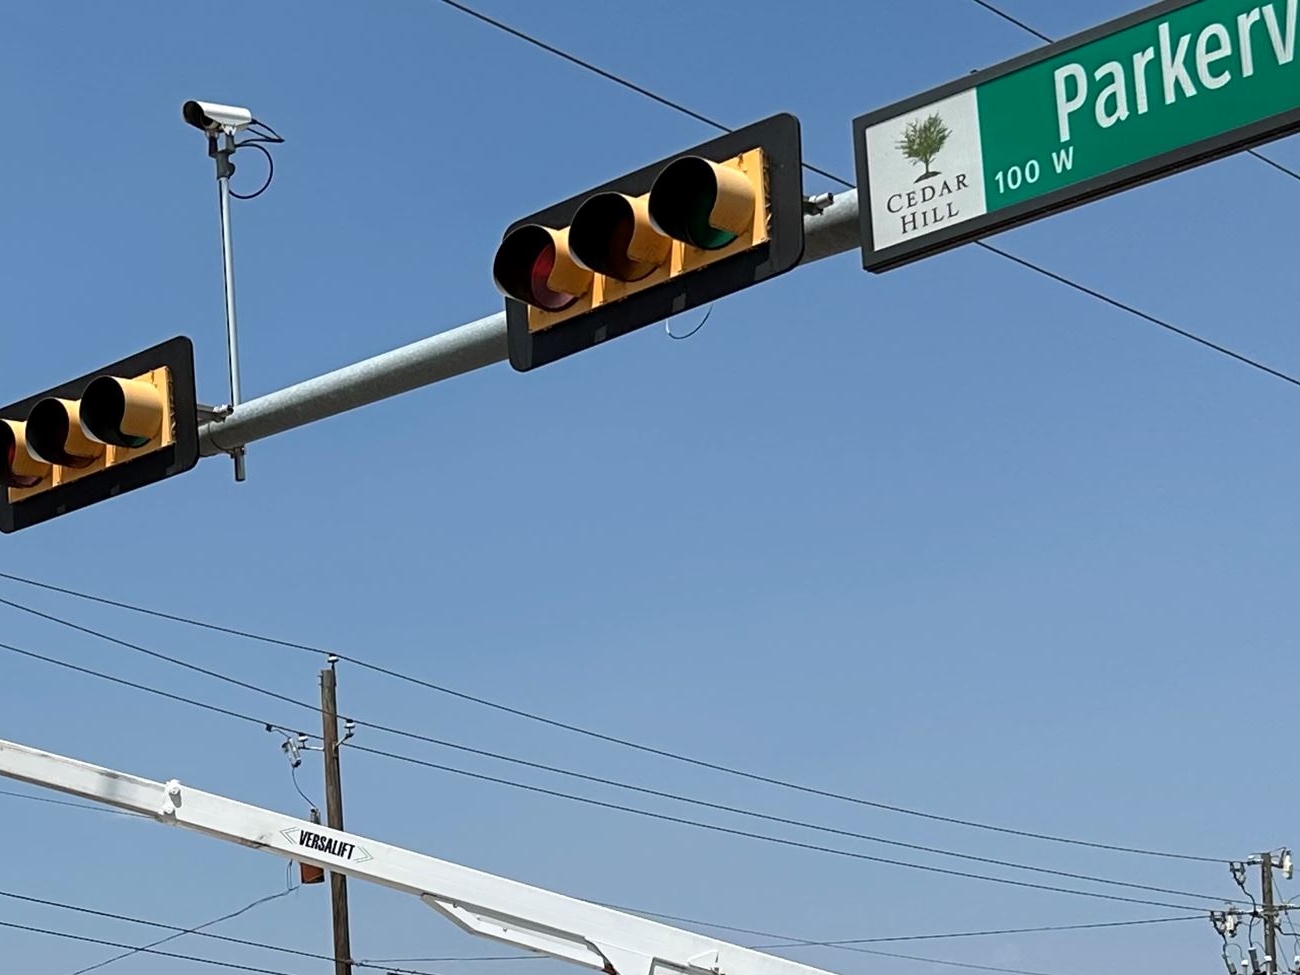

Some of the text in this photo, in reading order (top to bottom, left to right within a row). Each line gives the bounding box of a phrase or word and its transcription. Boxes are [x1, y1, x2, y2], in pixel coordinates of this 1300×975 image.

[1053, 0, 1299, 143] Parkerv
[994, 146, 1075, 194] 100 W
[887, 173, 969, 214] CEDAR
[901, 205, 960, 234] HILL
[299, 829, 356, 860] VERSALIFT
